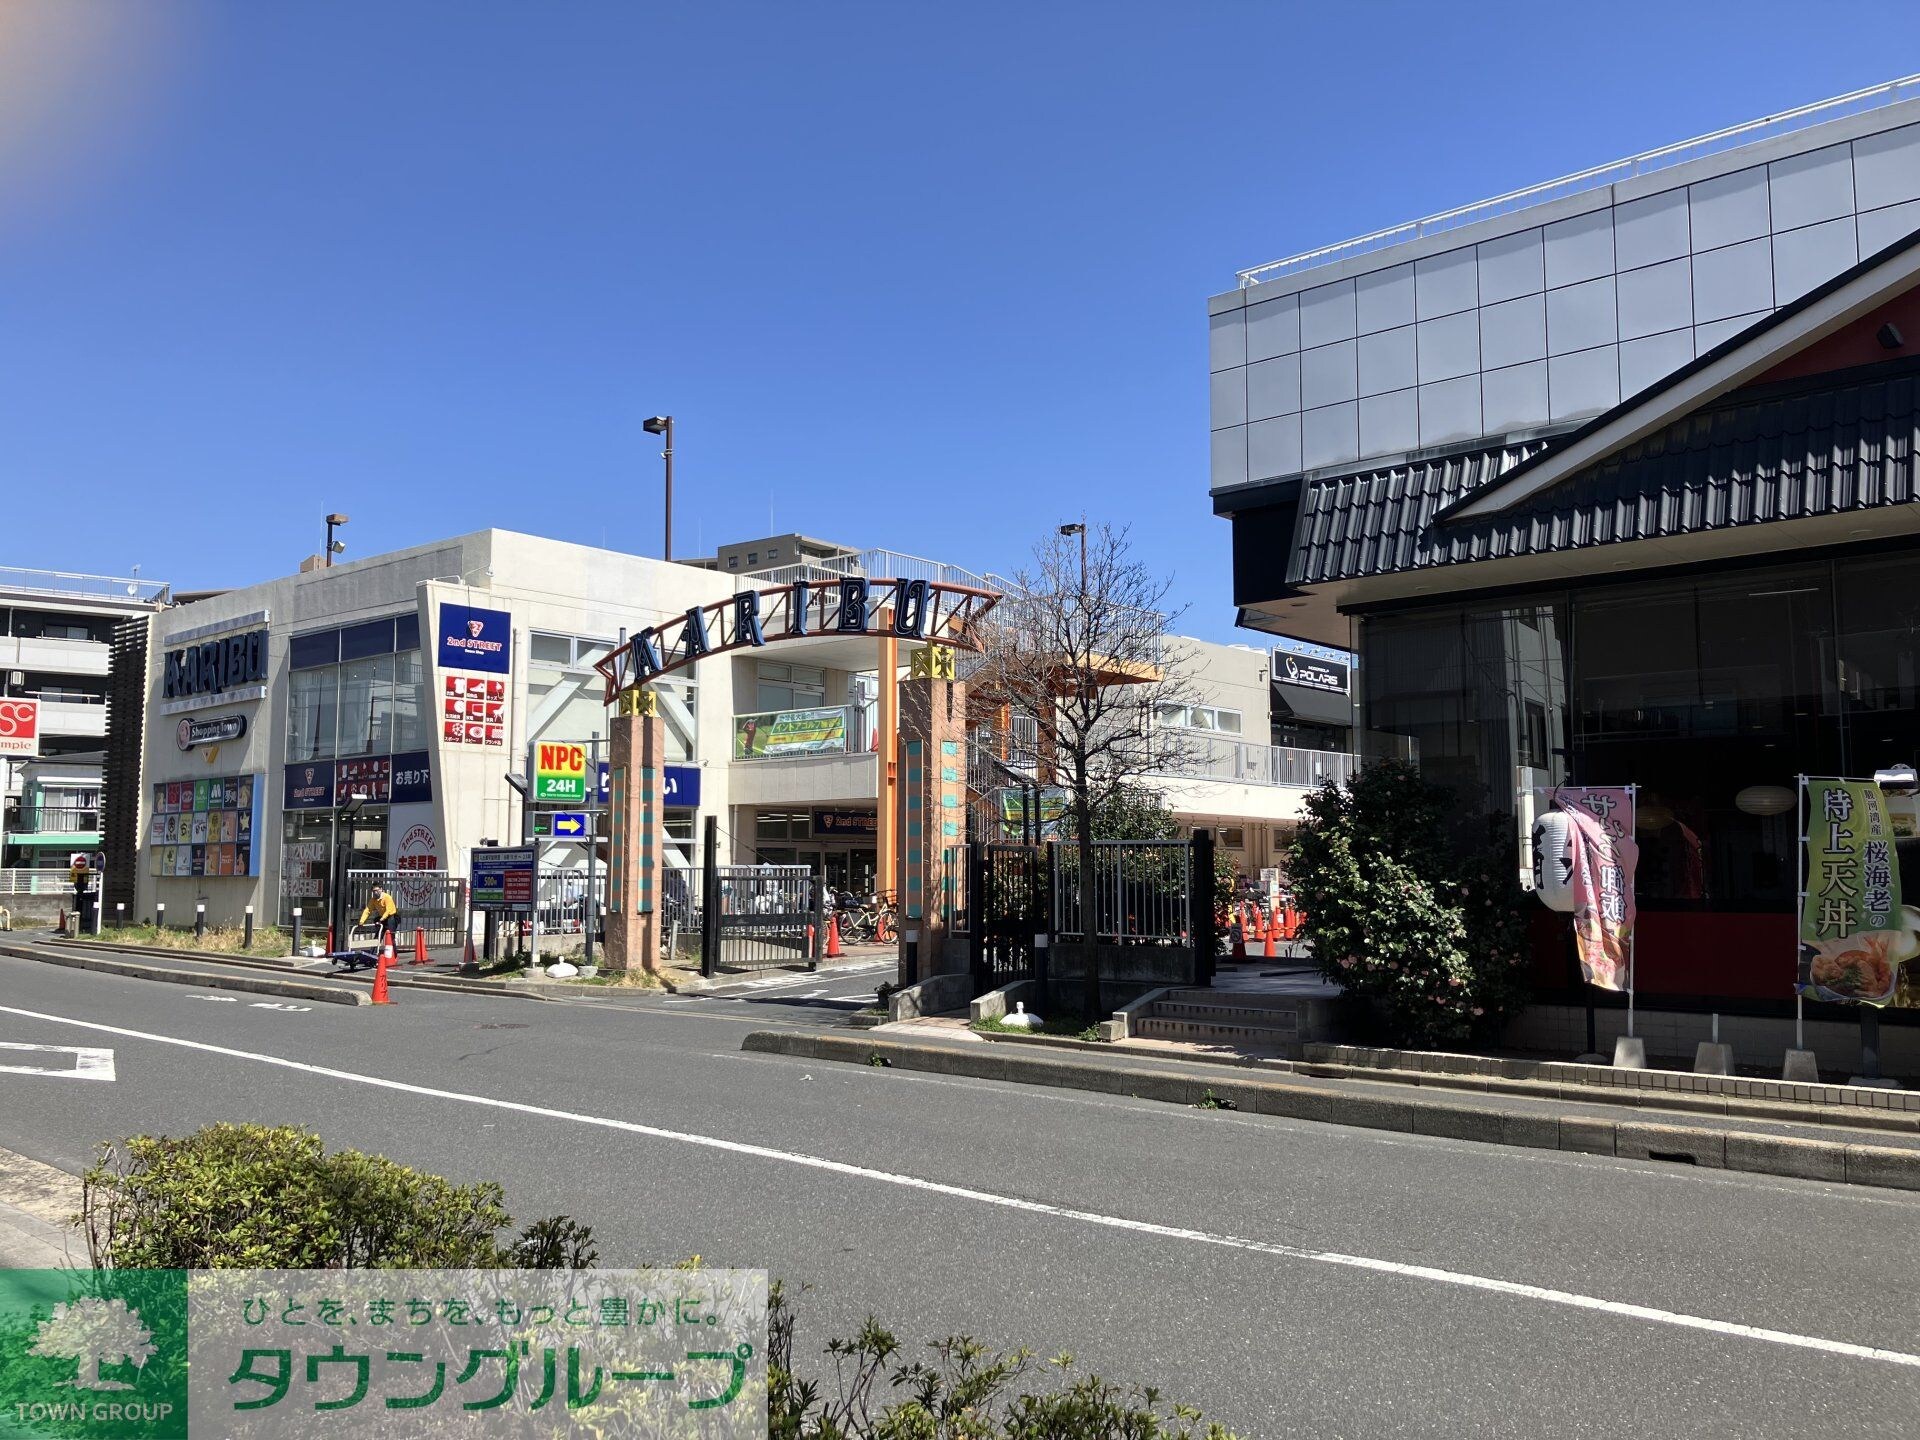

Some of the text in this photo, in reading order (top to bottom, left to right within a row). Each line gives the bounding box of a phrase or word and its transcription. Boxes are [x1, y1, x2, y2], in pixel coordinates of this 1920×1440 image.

[629, 577, 930, 681] KARIBU
[447, 636, 502, 652] 2nd STREET
[162, 630, 269, 698] KARIBU
[1299, 669, 1338, 685] POLARIS
[191, 721, 237, 738] Shopping Town
[540, 745, 583, 771] NPC
[395, 769, 431, 785] お売り下
[546, 779, 576, 792] 24H
[852, 817, 878, 827] STREE
[413, 829, 435, 849] STREET
[1817, 788, 1859, 939] 特上天丼
[1864, 840, 1892, 928] 桜海老の
